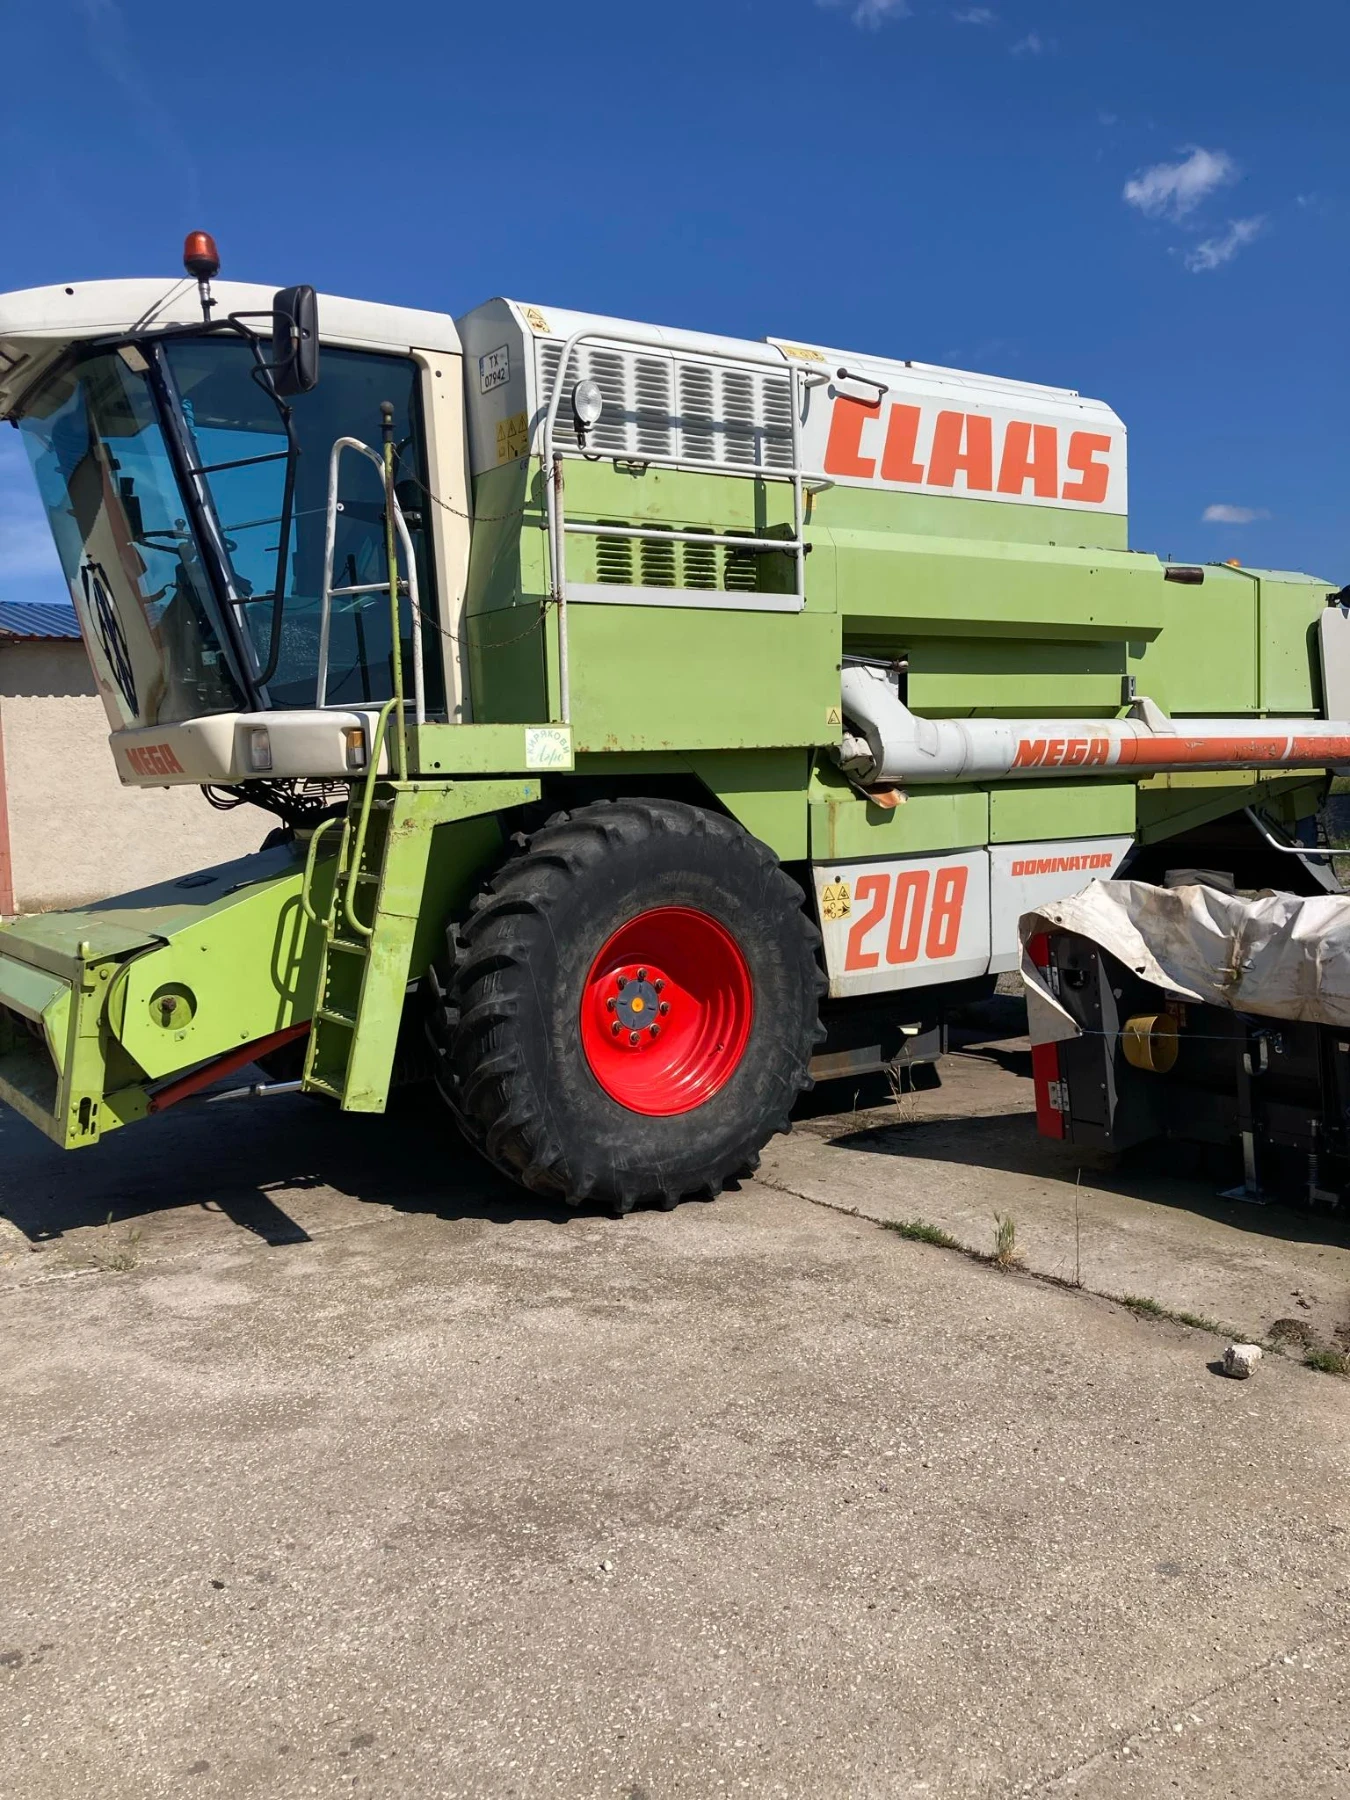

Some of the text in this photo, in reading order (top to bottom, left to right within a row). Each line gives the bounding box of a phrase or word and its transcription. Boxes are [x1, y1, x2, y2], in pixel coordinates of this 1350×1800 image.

[489, 353, 499, 368] TX
[485, 367, 505, 387] 07942
[823, 396, 1112, 504] CLAAS
[124, 743, 185, 776] MEGA
[1011, 738, 1110, 768] MEGA
[1011, 853, 1112, 876] DOMINATOR
[844, 866, 968, 971] 208
